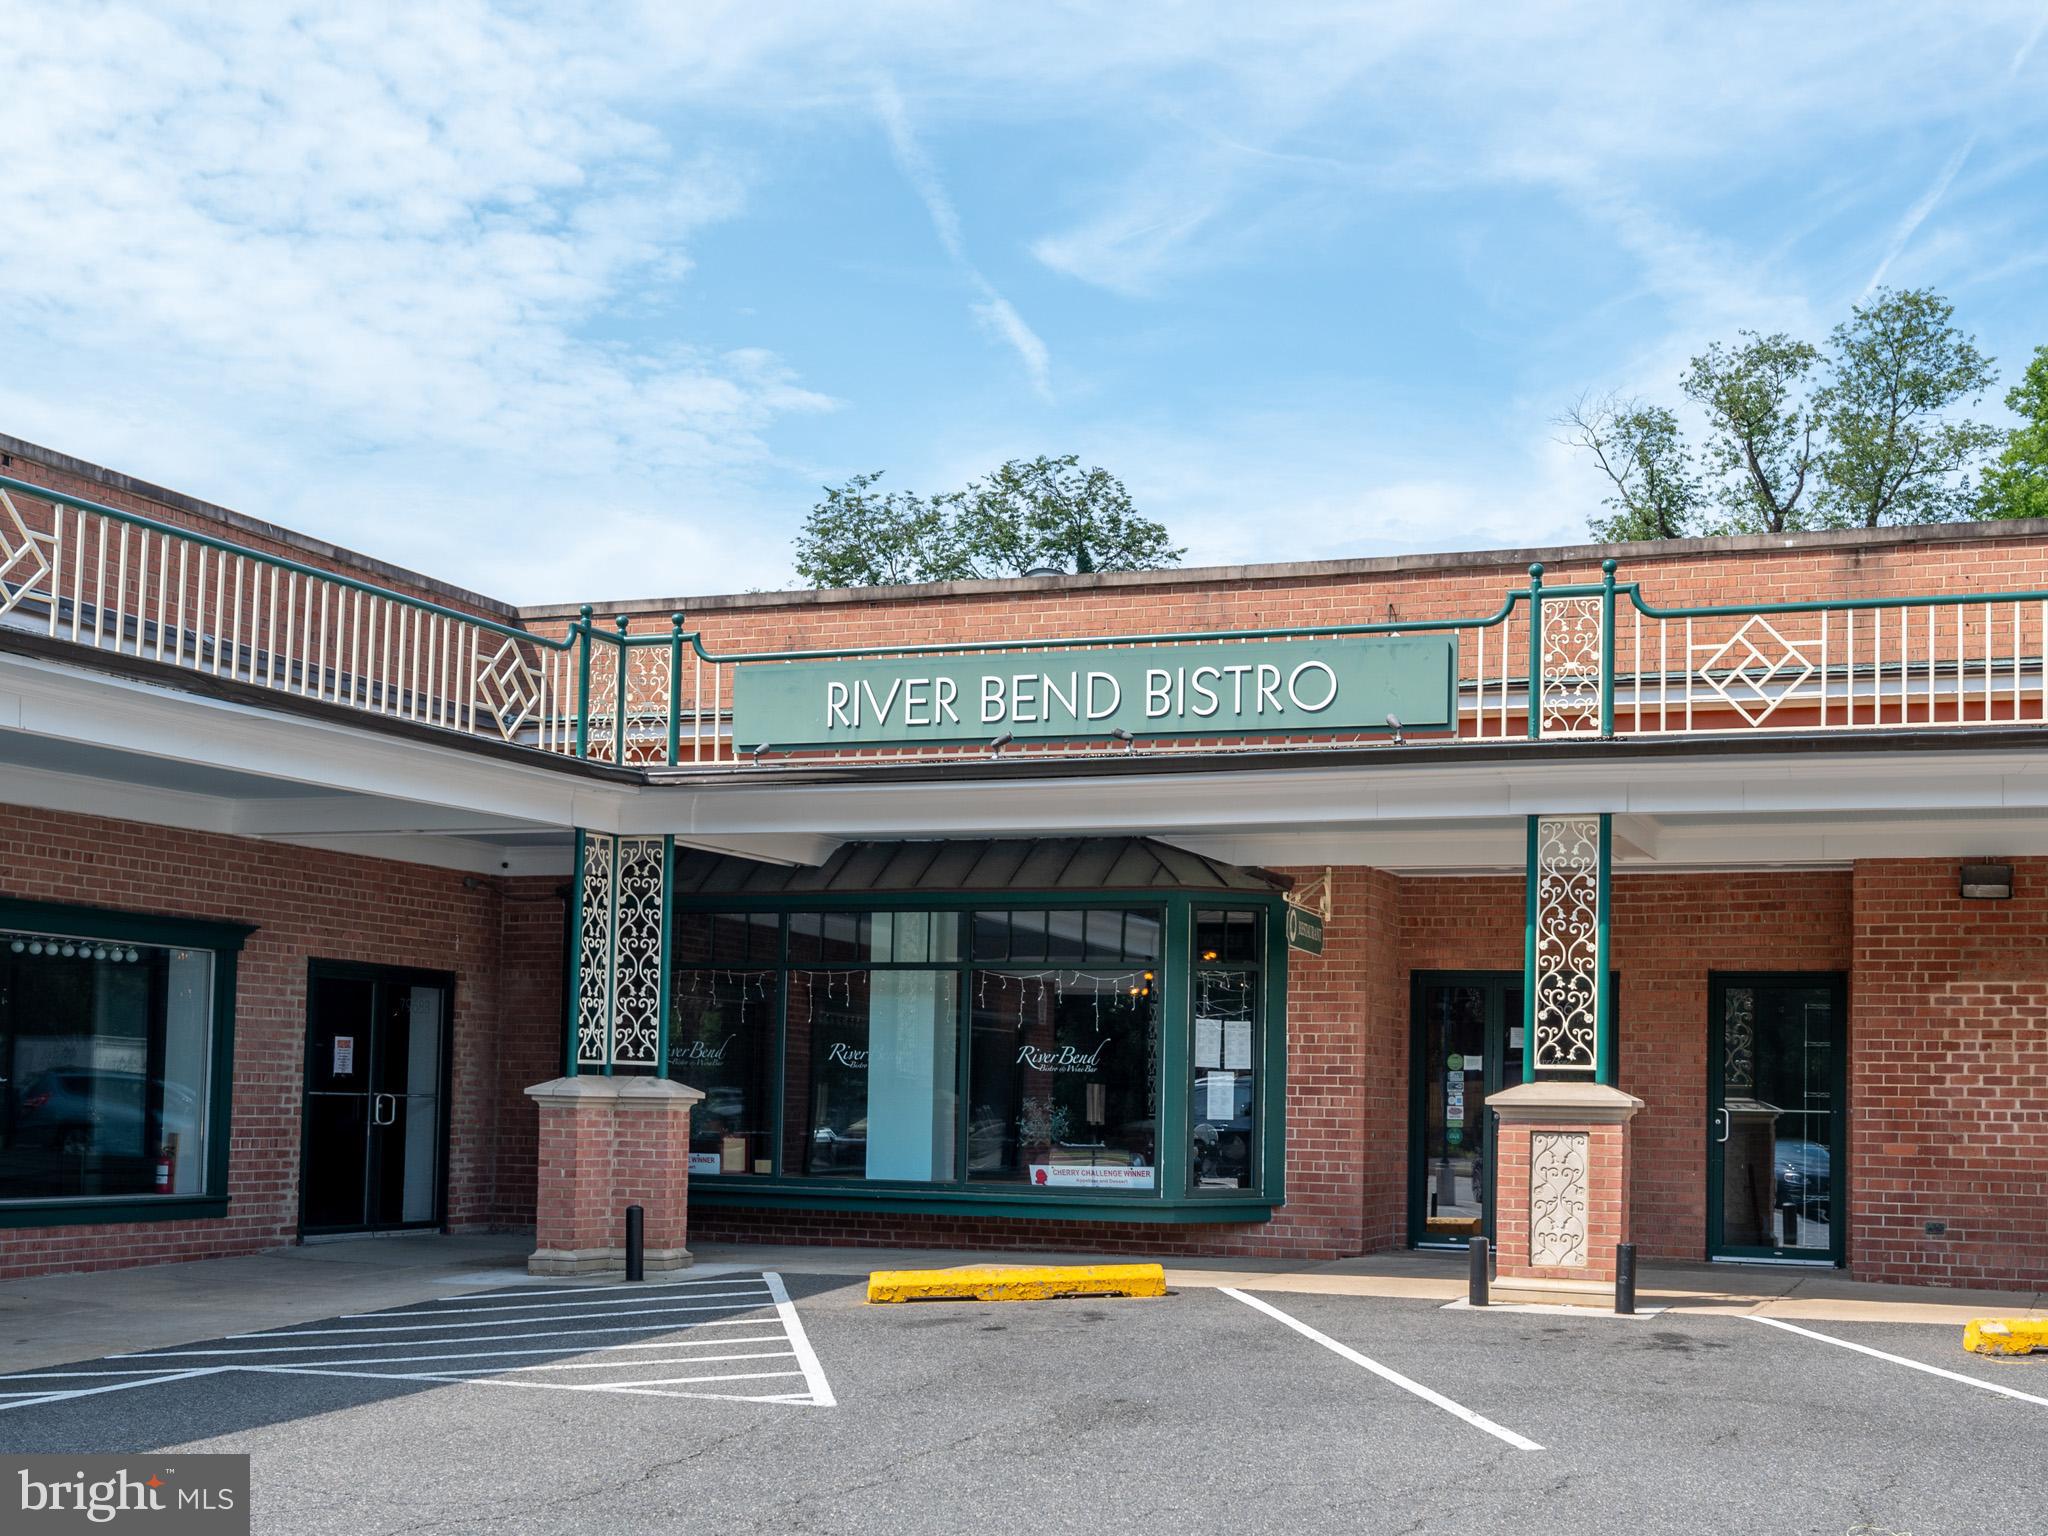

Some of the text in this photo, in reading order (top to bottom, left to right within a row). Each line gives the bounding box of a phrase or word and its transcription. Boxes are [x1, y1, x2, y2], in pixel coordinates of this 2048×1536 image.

[827, 660, 1338, 728] RIVER BEND BISTRO
[689, 1033, 737, 1060] Bend
[828, 1042, 870, 1067] River
[1016, 1038, 1111, 1070] River Bend
[1052, 1168, 1151, 1178] CHERRY CHALLENGE WINNER
